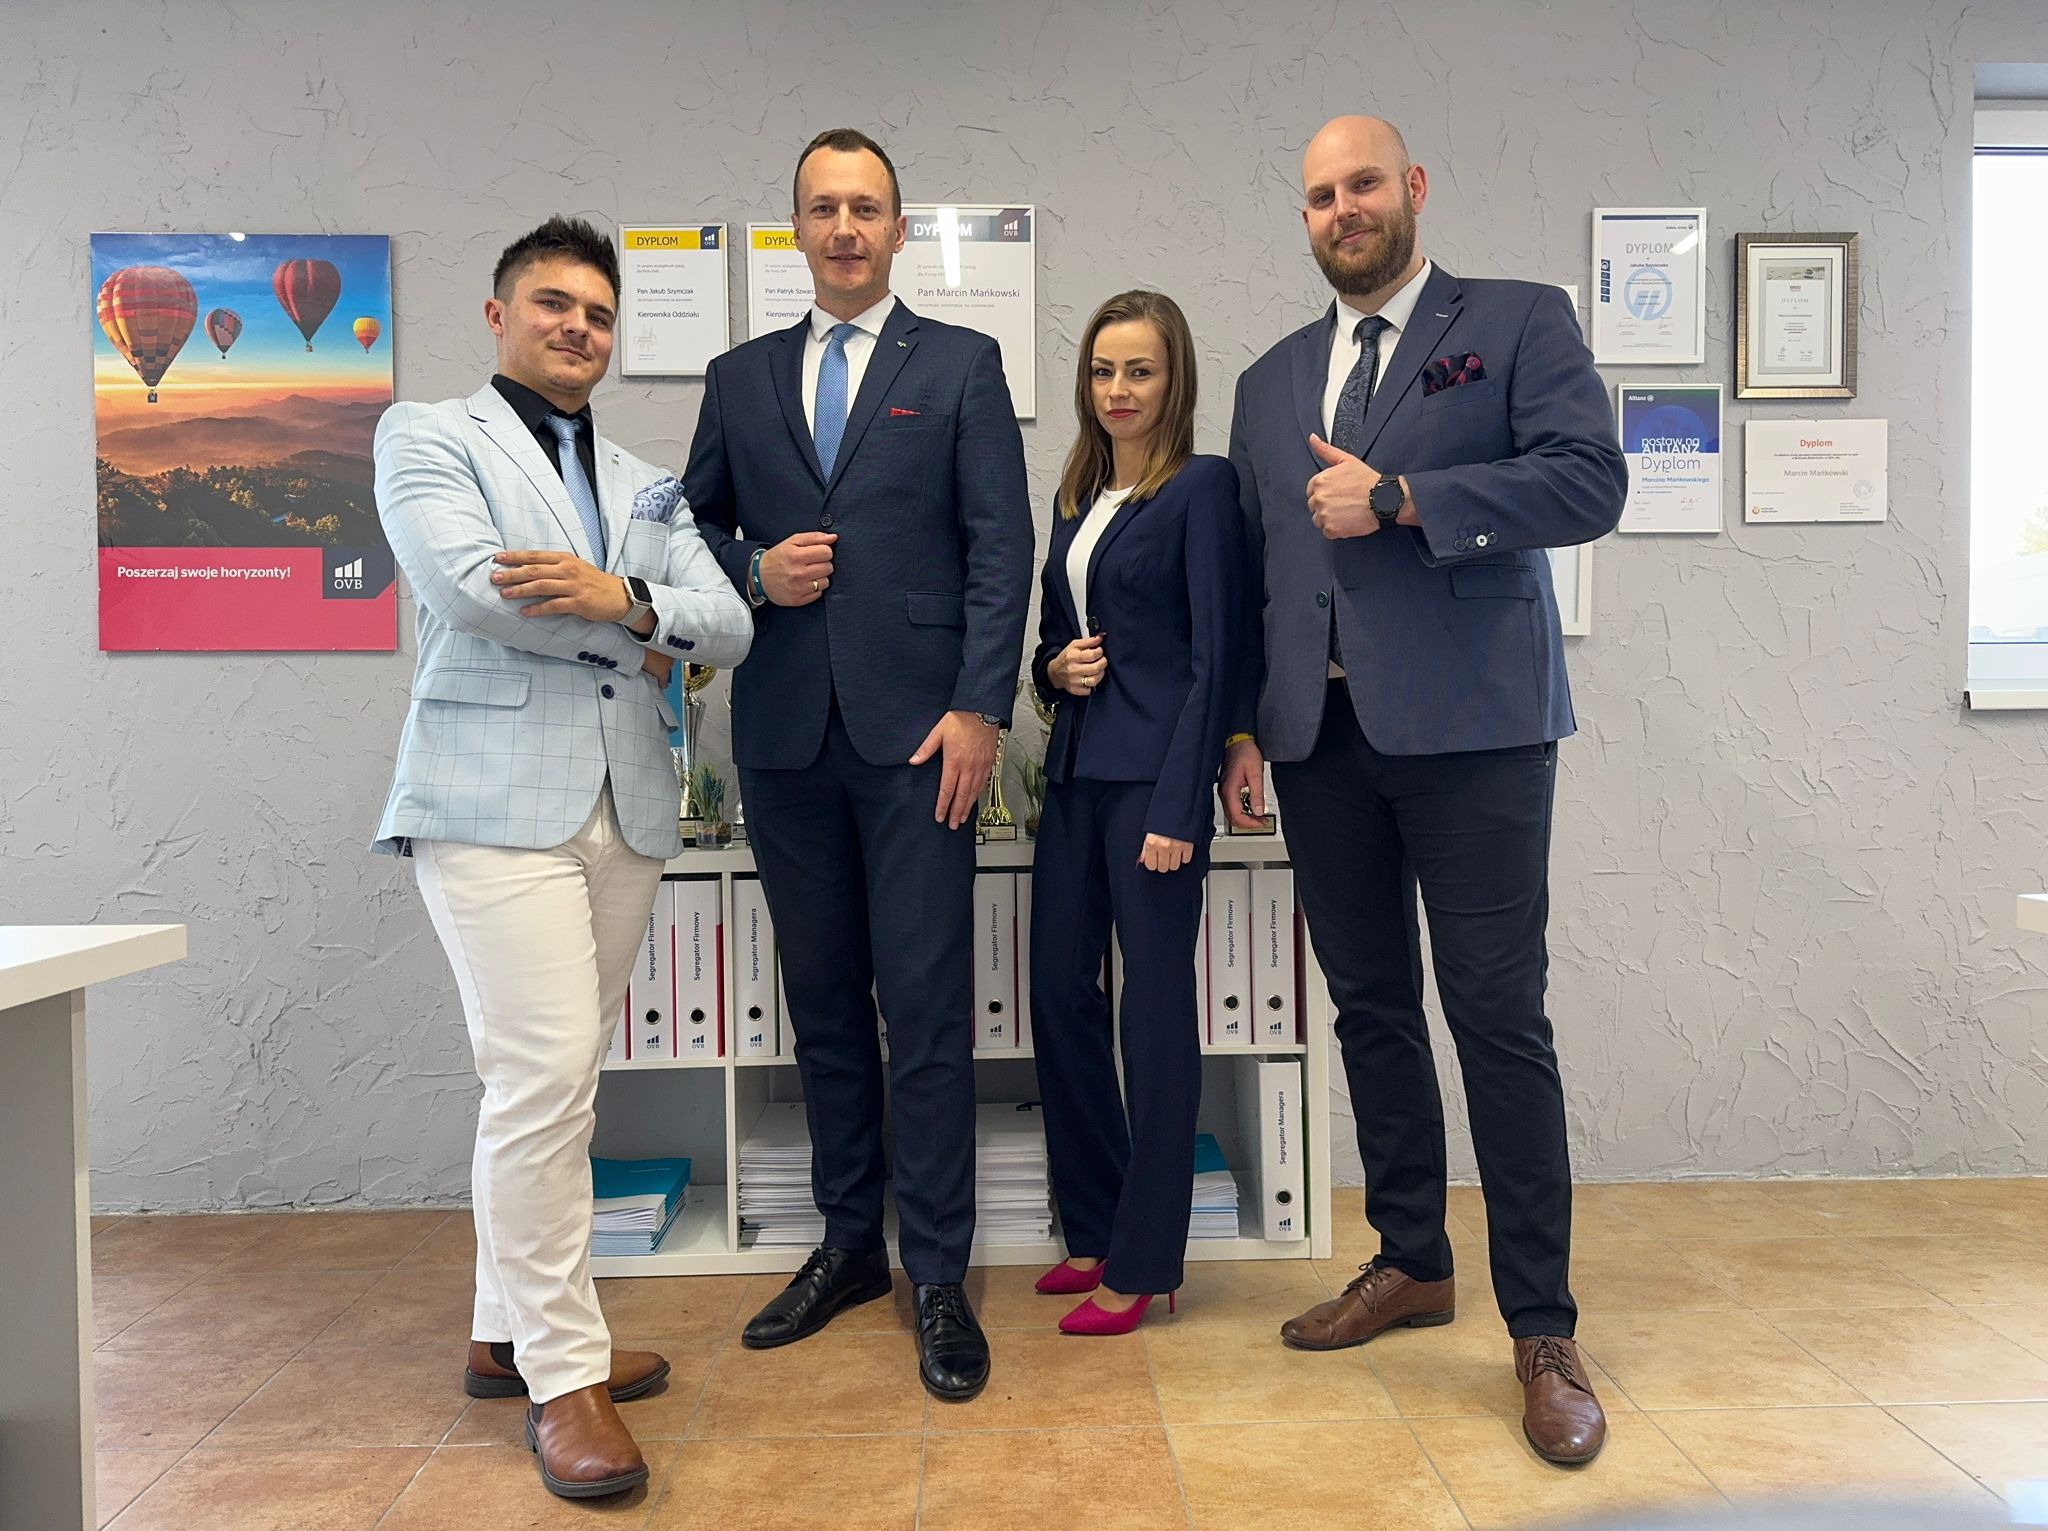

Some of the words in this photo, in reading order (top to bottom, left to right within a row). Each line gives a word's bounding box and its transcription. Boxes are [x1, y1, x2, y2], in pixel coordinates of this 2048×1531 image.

[914, 223, 973, 237] DYPM
[636, 236, 678, 246] DYPLOM
[764, 236, 797, 246] DYPLO
[1626, 242, 1674, 254] DYPLOM
[667, 288, 694, 296] Szymczak
[776, 288, 794, 296] Patryk
[917, 288, 934, 297] Pan
[936, 288, 968, 297] Marcin
[970, 288, 1020, 298] Mańkowski
[1642, 436, 1682, 448] postaw
[1686, 438, 1700, 446] na
[1642, 444, 1700, 454] ALLIANZ
[1800, 438, 1833, 449] Dyplom
[1642, 456, 1701, 473] Dyplom
[117, 566, 179, 580] Poszerzaj
[180, 567, 218, 580] swoje
[220, 566, 291, 580] horyzonty!
[334, 579, 363, 590] OVB
[1226, 900, 1235, 929] Firmowy
[1270, 900, 1278, 929] Firmowy
[693, 912, 701, 942] Firmowy
[991, 934, 999, 971] Segregator
[1227, 930, 1236, 968] Segregator
[1270, 930, 1278, 968] Segregator
[648, 943, 656, 981] Segregator
[694, 942, 702, 981] Segregator
[1276, 1091, 1286, 1125] Managera
[1278, 1126, 1286, 1165] Segregator
